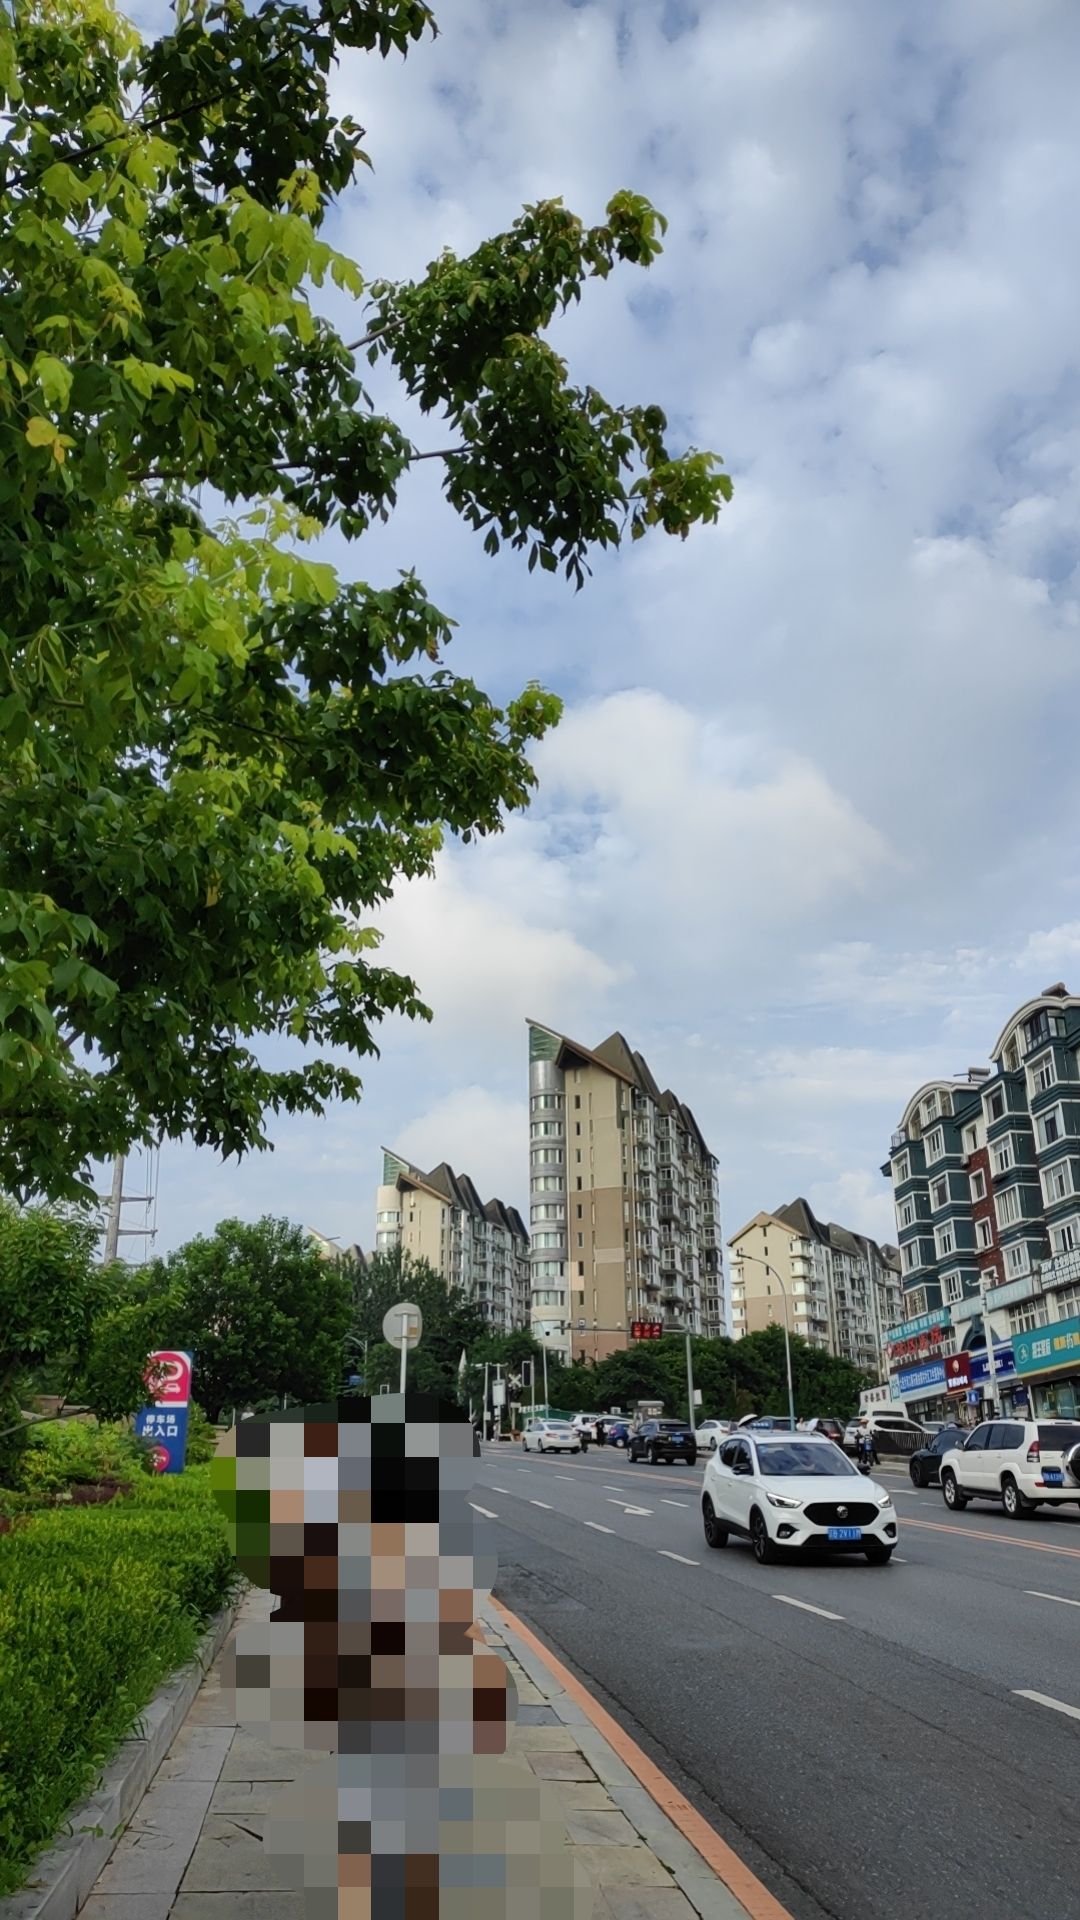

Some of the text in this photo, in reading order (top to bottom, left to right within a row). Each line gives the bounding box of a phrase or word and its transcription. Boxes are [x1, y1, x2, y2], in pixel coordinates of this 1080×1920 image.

[146, 1414, 176, 1424] 停车场
[142, 1425, 178, 1438] 出入口
